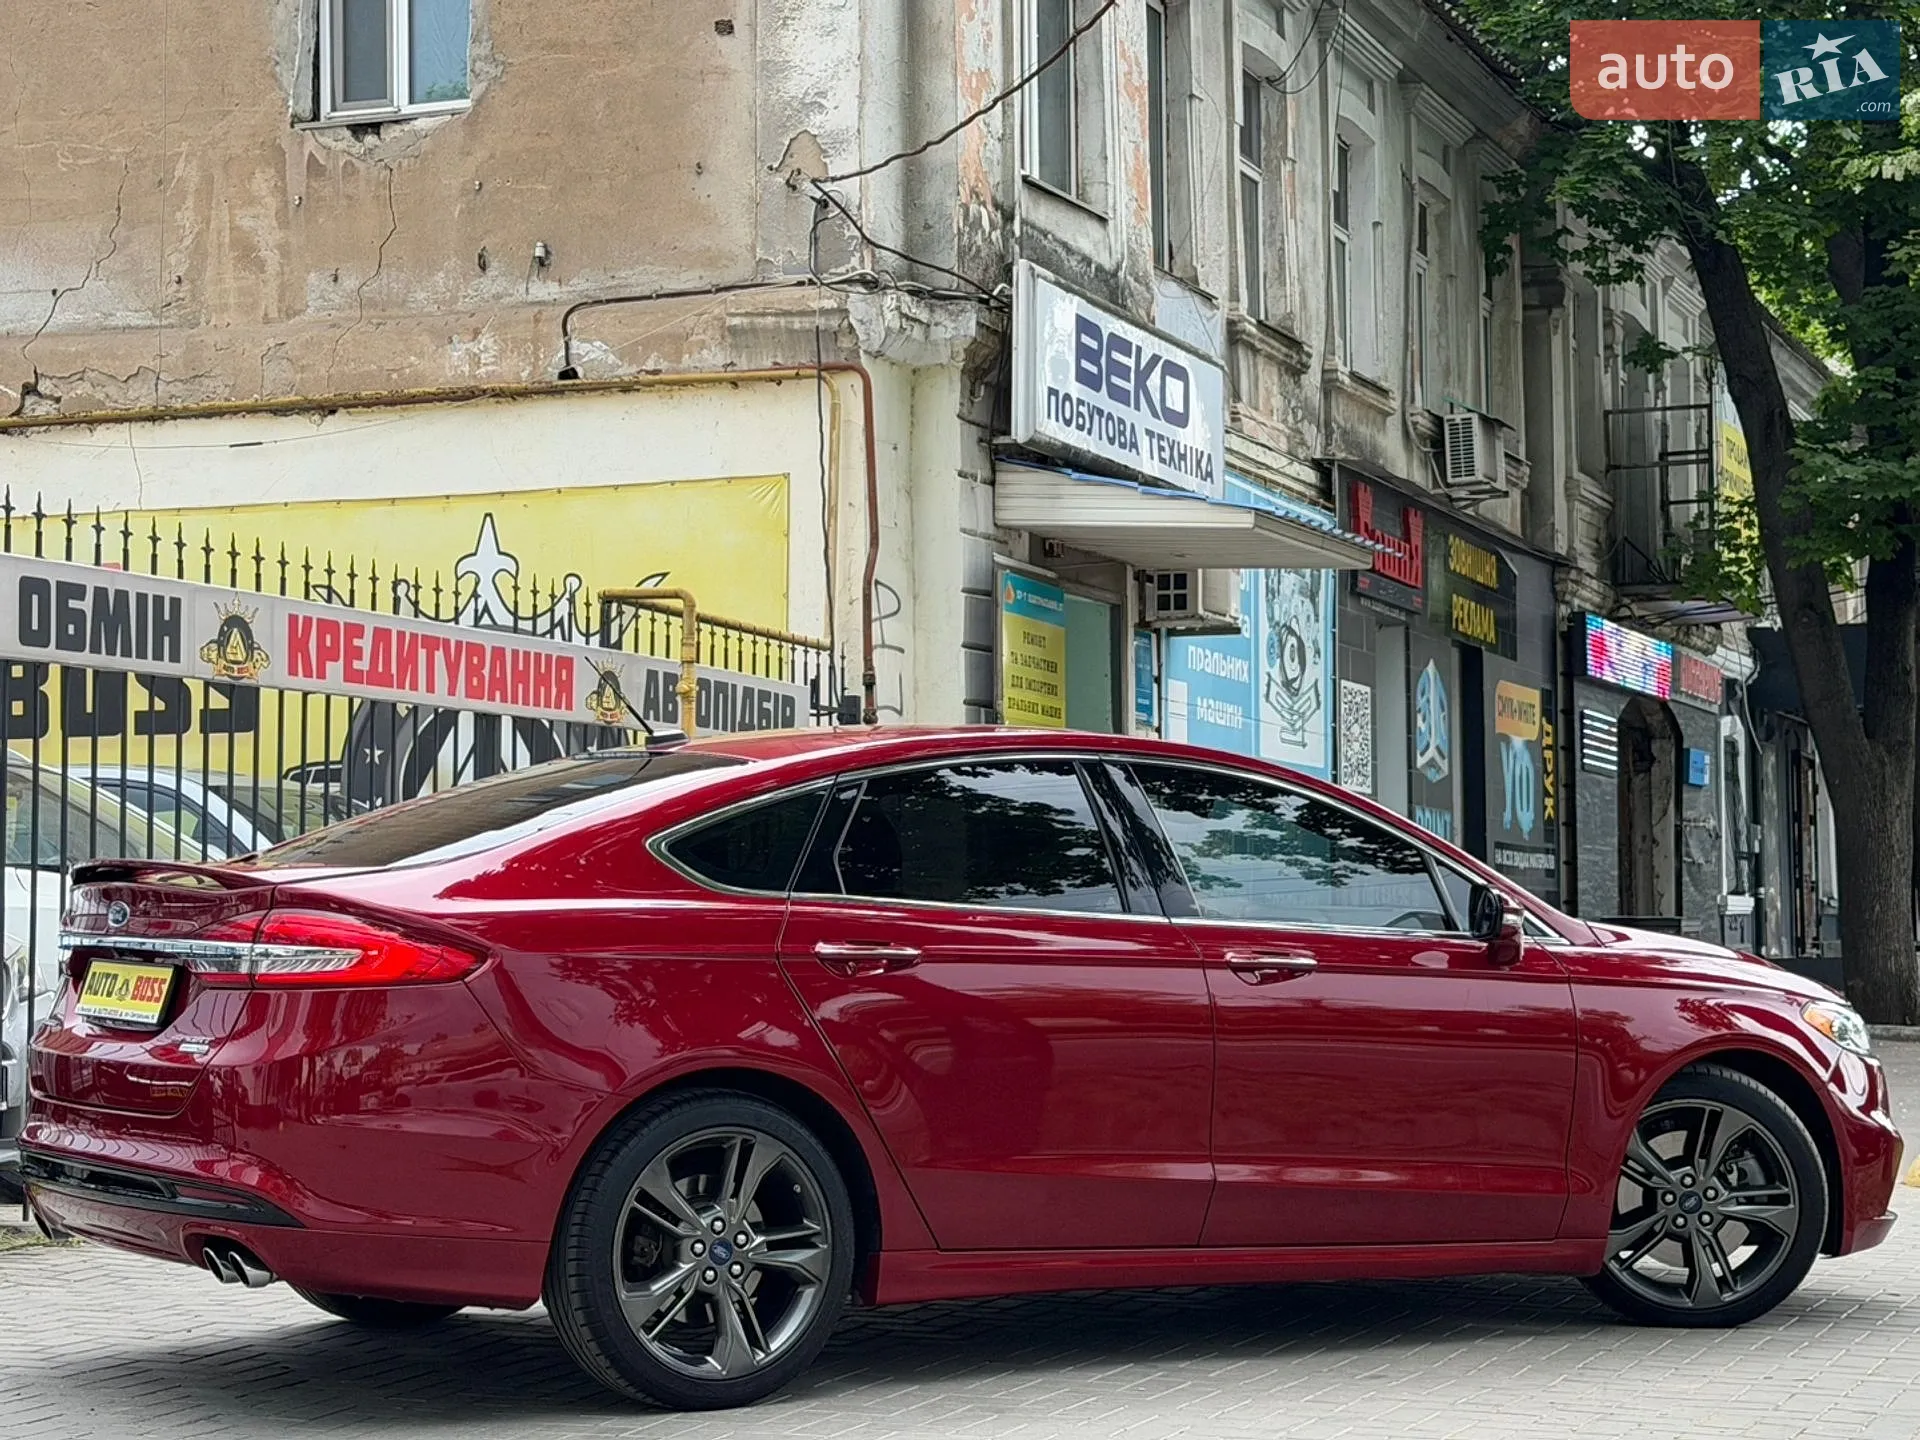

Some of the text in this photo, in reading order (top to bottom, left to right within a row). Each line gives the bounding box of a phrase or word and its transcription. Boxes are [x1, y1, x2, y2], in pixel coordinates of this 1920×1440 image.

[1075, 313, 1190, 430] BEKO
[1047, 386, 1214, 485] ПОБУТОВА ТЕХНІКА
[18, 575, 182, 663] ОБМІН
[1452, 593, 1496, 645] РЕКЛАМА
[287, 612, 575, 711] КРЕДИТУВАННЯ
[1188, 644, 1249, 684] пральних
[643, 668, 796, 733] АВОПІДБІР
[1197, 696, 1242, 729] машин
[1542, 716, 1554, 821] ДРУК
[84, 971, 167, 1004] AUTO BOSS
